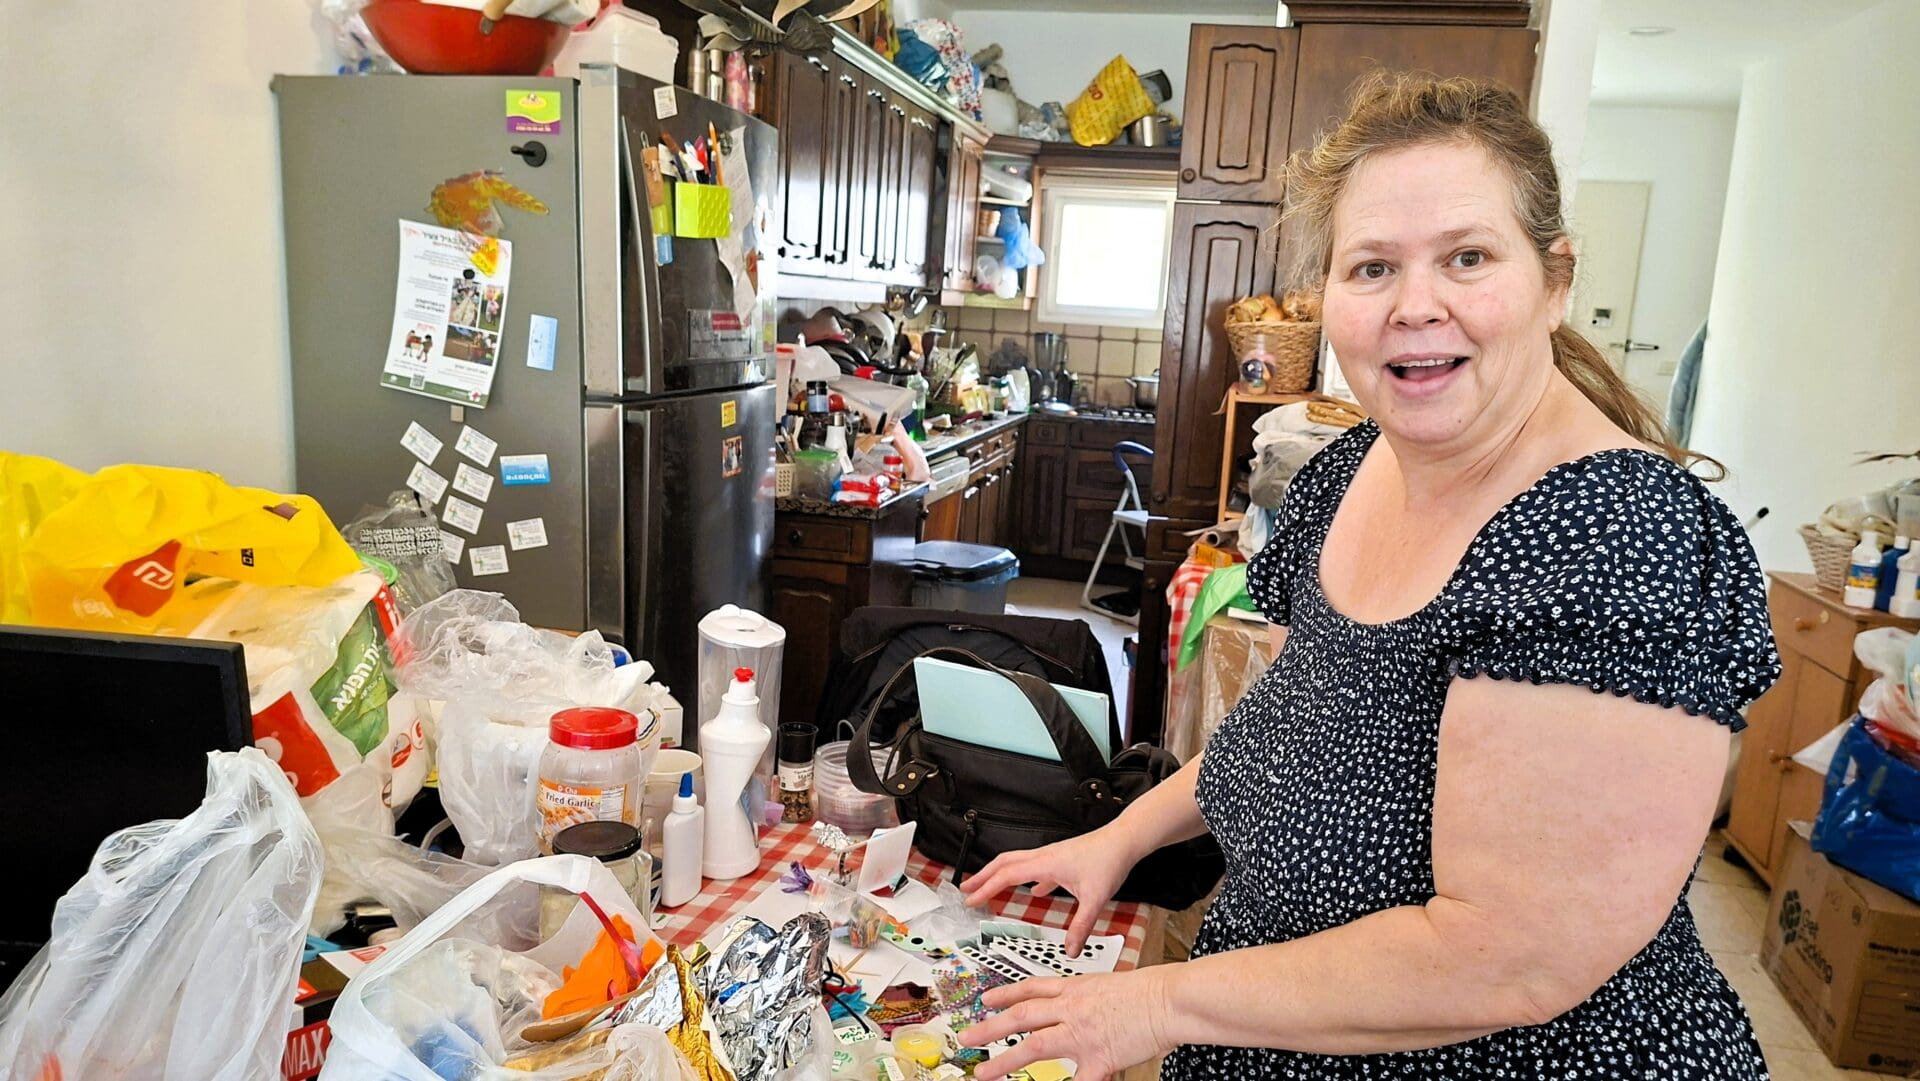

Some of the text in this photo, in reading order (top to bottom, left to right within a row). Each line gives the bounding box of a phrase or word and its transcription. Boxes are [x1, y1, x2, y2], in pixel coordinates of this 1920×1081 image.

[546, 791, 595, 808] Fried Garlic
[285, 1027, 326, 1078] MAX
